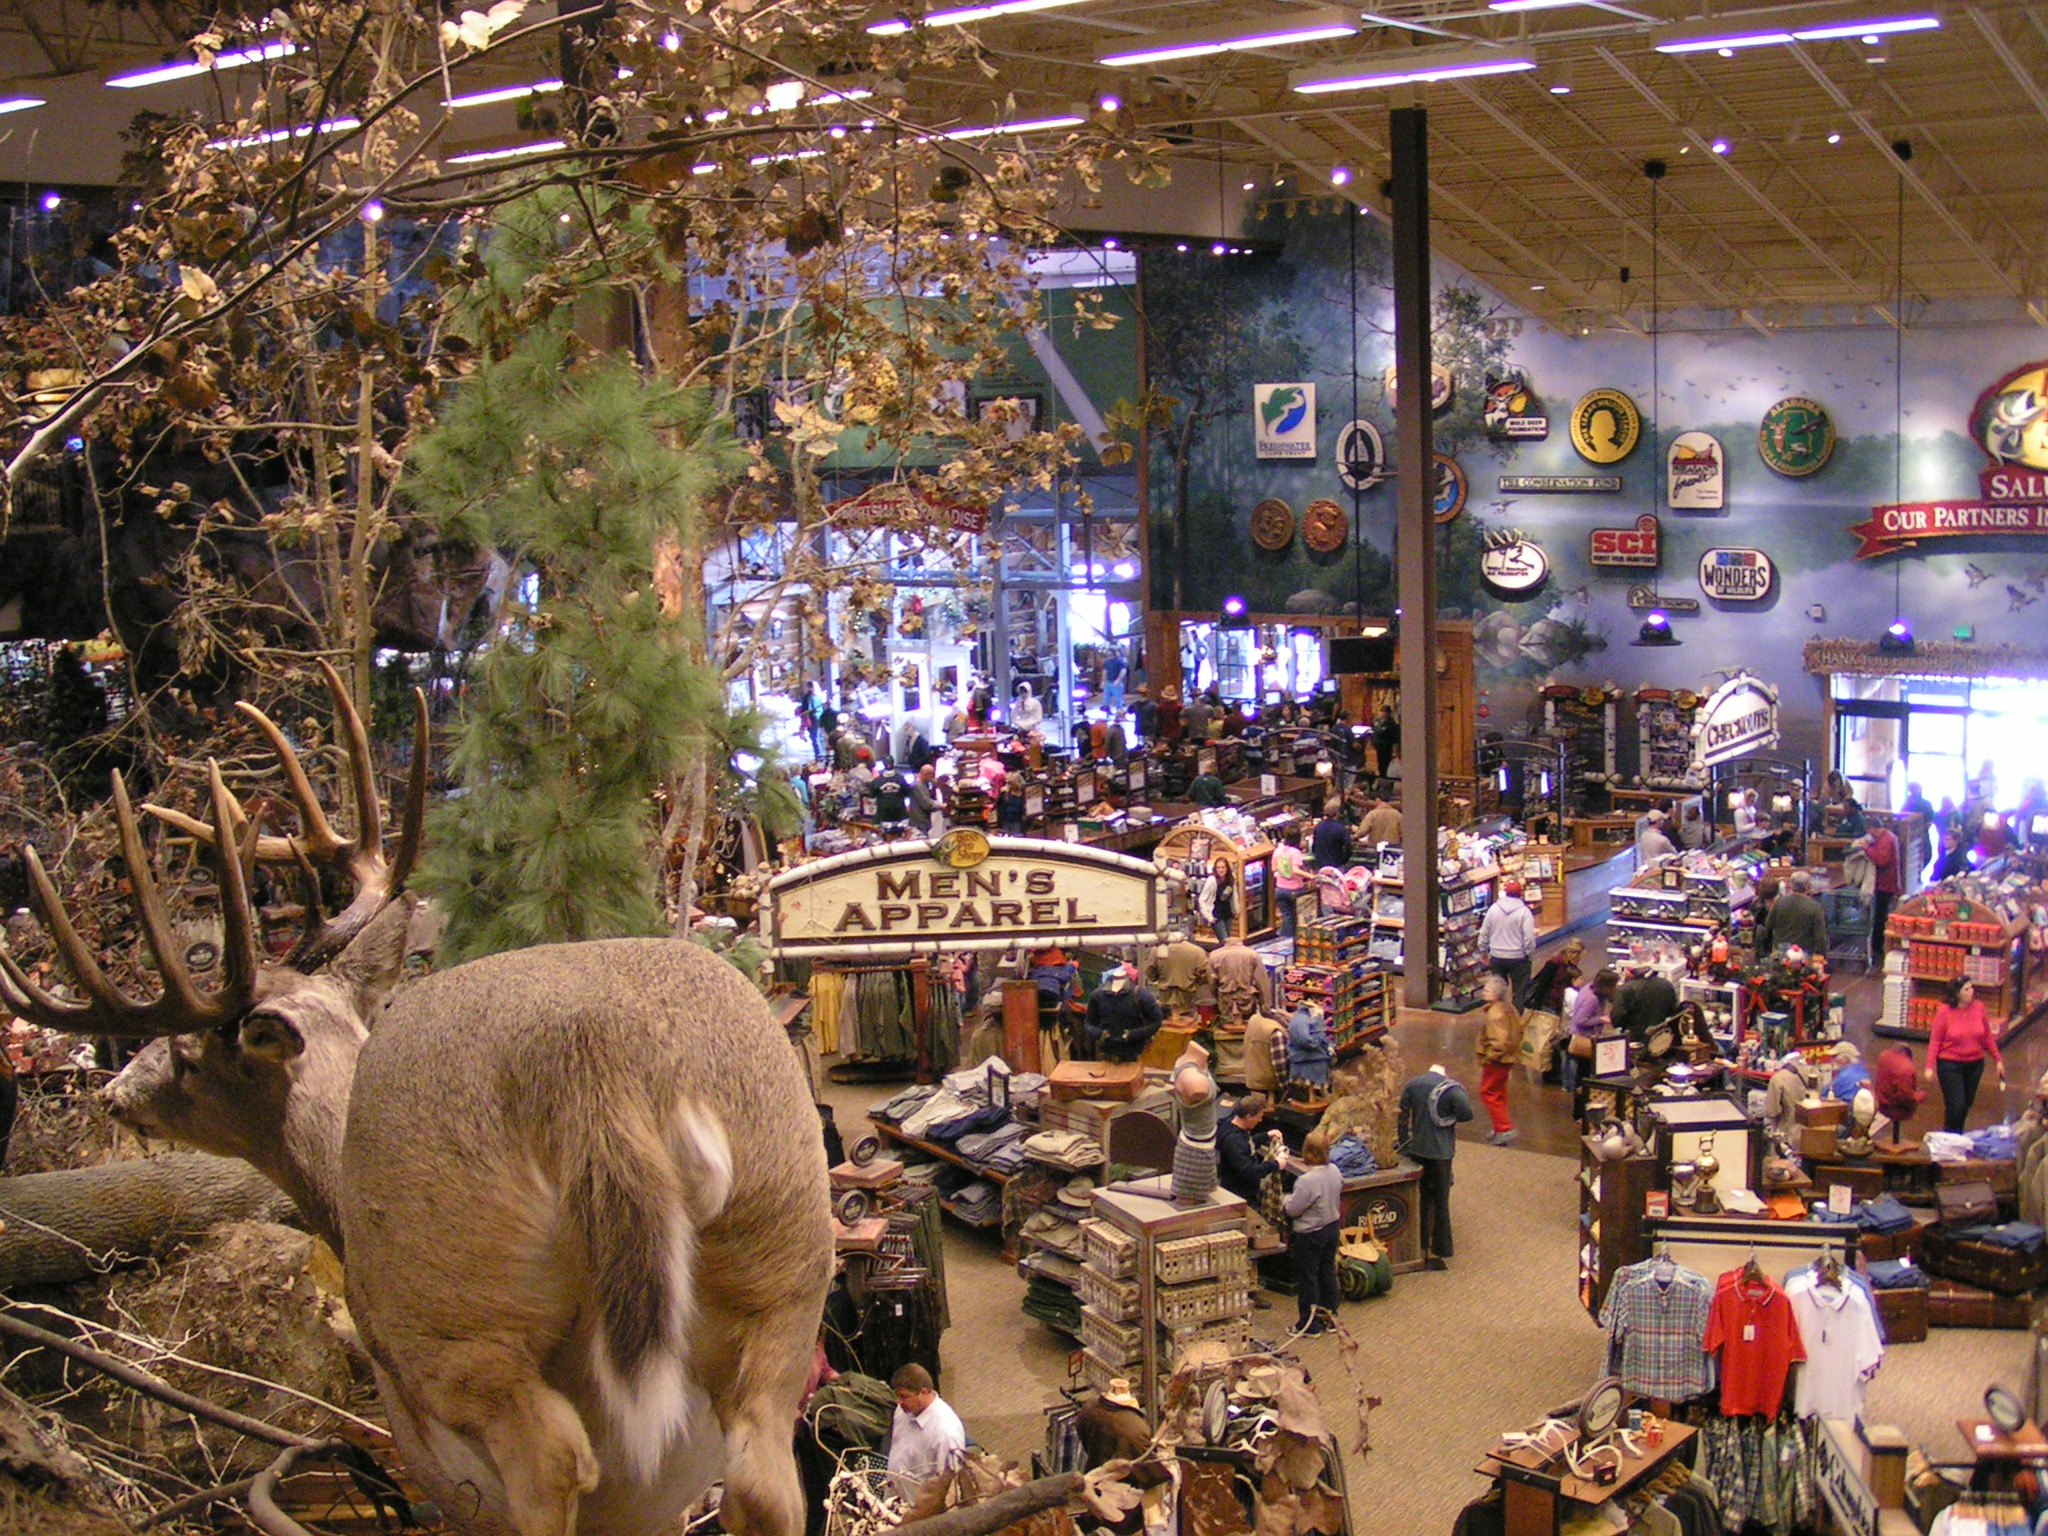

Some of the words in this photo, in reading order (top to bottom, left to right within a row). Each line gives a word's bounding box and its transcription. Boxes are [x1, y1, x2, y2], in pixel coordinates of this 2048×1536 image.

[1883, 509, 1927, 531] OUR
[1933, 507, 2029, 528] PARTNERS
[1593, 532, 1656, 554] SCI
[1703, 564, 1767, 588] WONDERS
[1707, 707, 1769, 748] CHECKOUTS
[876, 868, 1056, 901] MEN'S
[833, 897, 1098, 933] APPAREL
